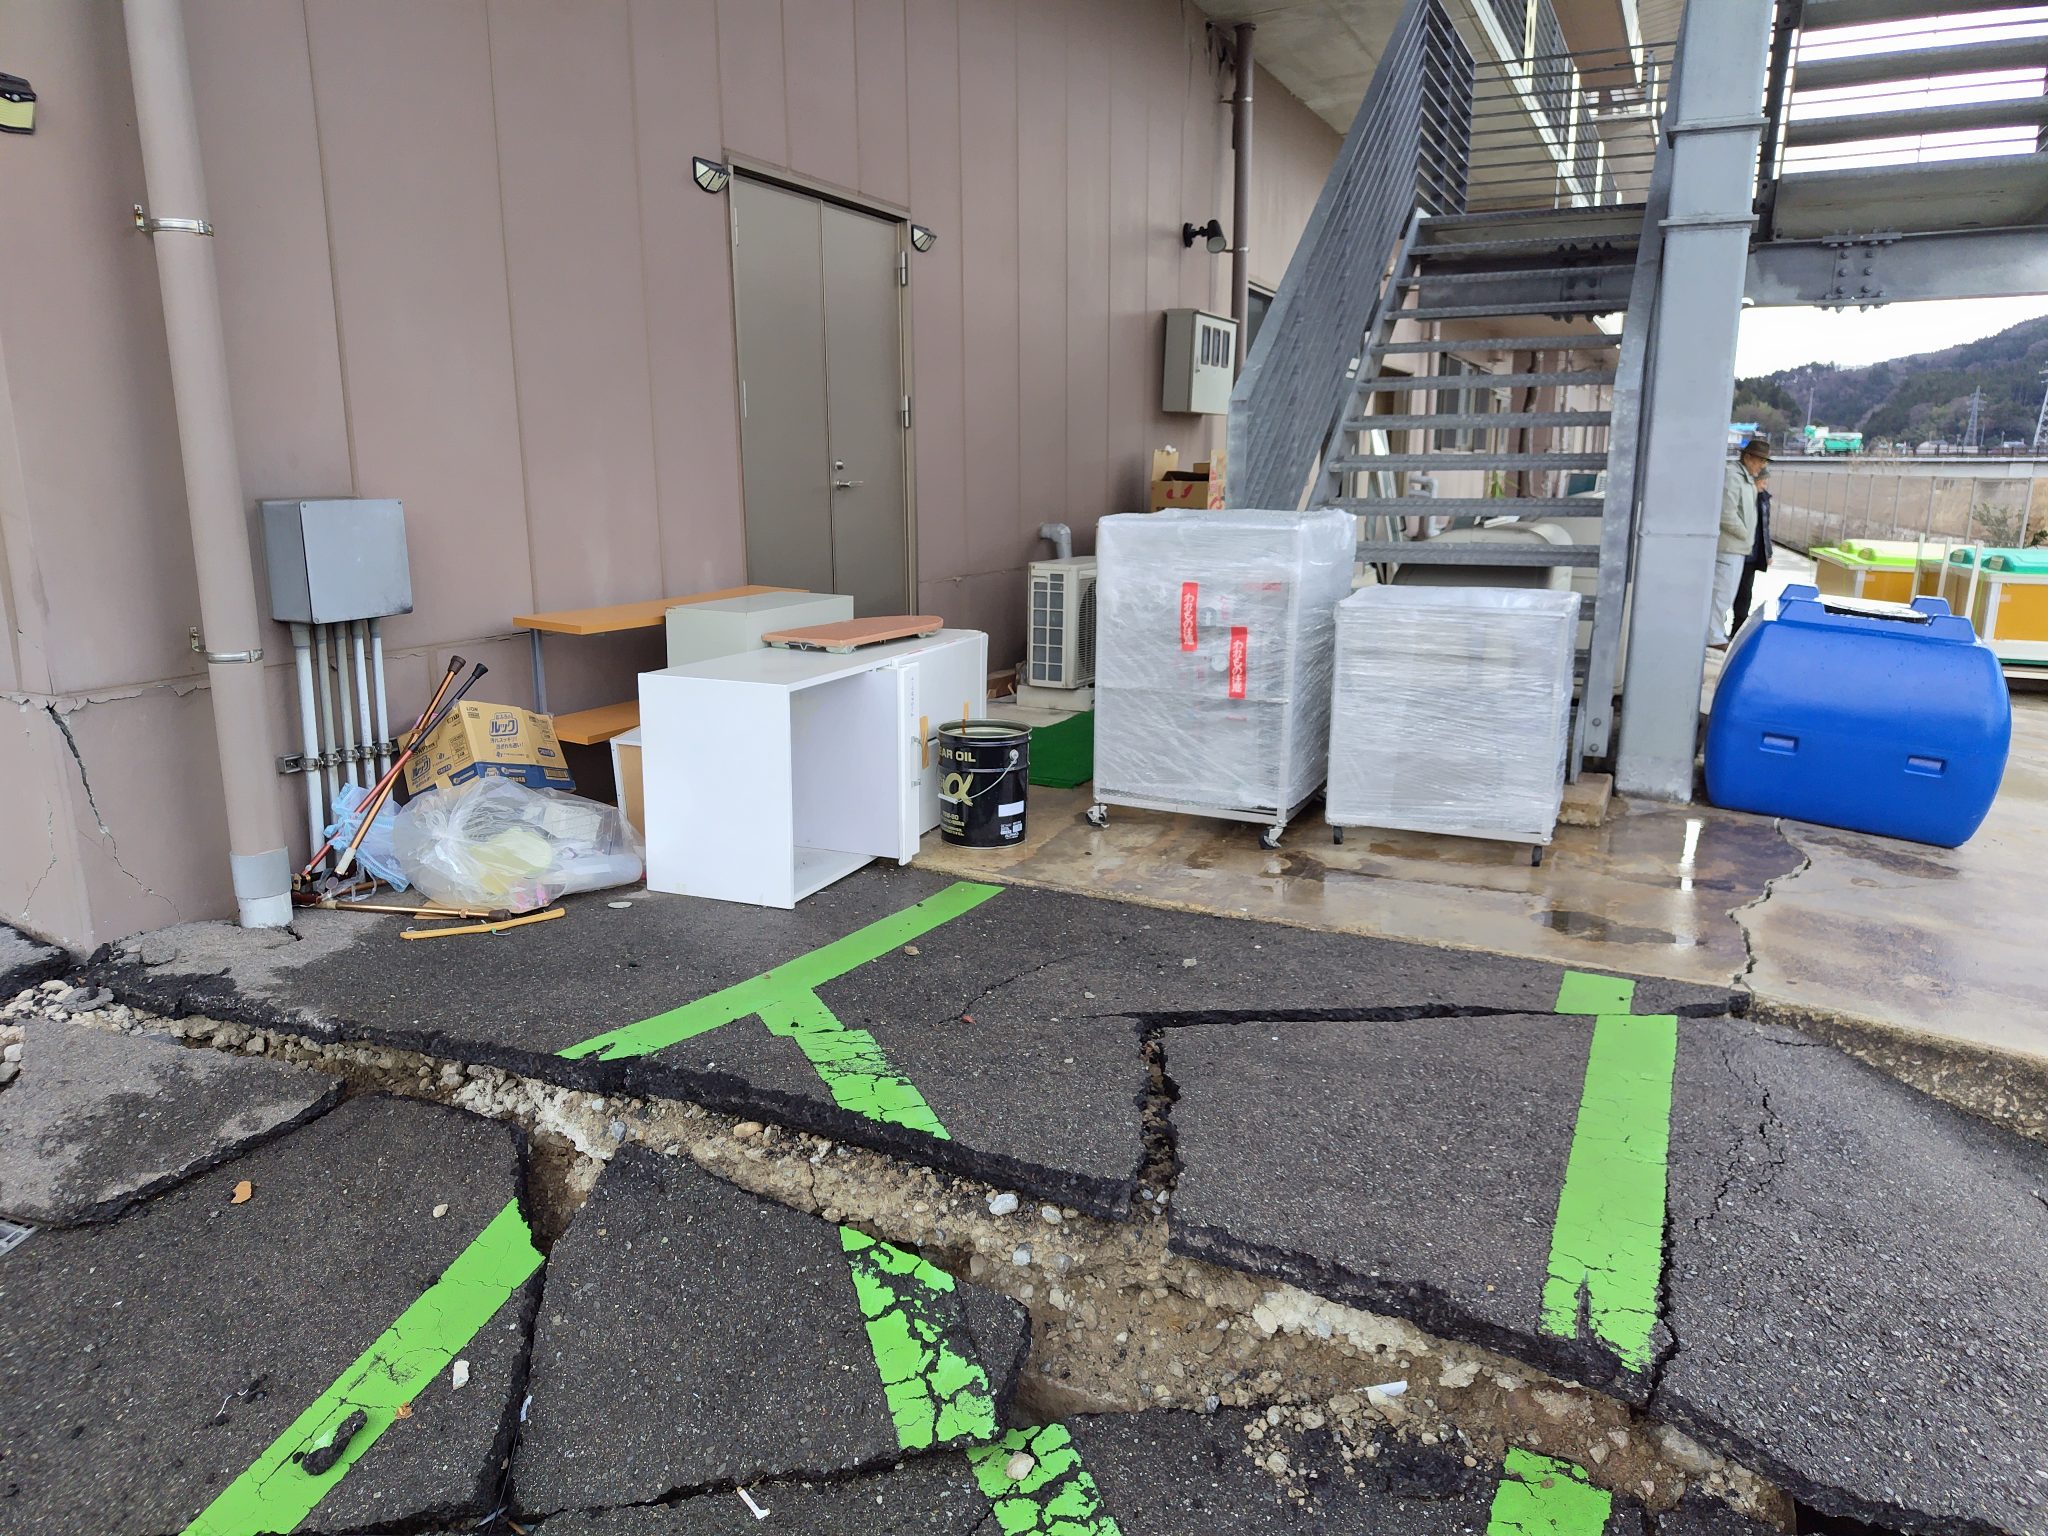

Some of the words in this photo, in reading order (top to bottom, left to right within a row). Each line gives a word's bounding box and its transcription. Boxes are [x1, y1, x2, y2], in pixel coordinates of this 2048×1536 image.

[1183, 592, 1195, 645] われもの注意
[1231, 639, 1243, 693] われもの注意
[490, 719, 515, 734] ルック
[955, 750, 977, 763] OIL
